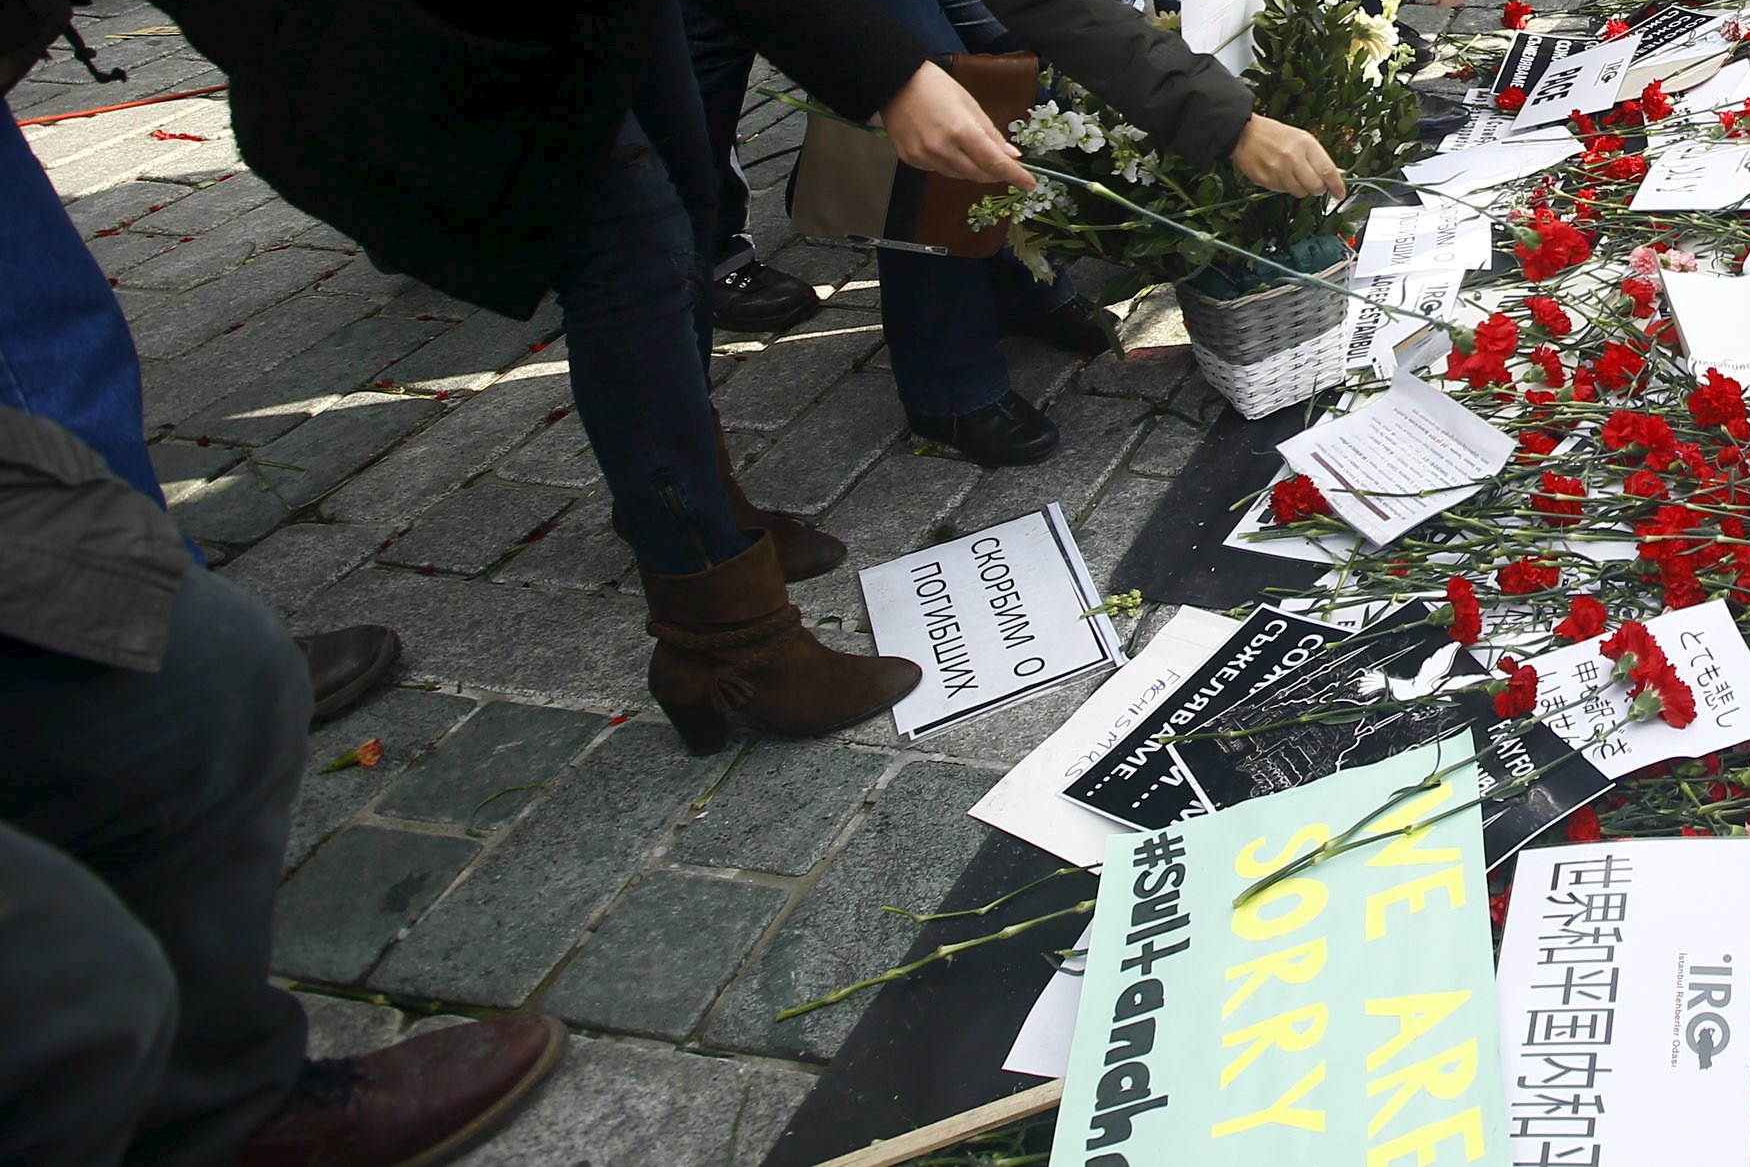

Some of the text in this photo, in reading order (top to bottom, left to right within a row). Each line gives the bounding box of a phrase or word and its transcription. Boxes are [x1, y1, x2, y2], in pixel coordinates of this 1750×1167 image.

[1531, 65, 1584, 107] PACE
[1345, 307, 1383, 363] ESTAMBUL
[910, 560, 981, 701] ПОГИБШИХ
[970, 535, 1031, 658] СКОРБИМ
[1085, 829, 1192, 1167] #Sultanah
[1209, 820, 1331, 1140] SORRY
[1363, 779, 1487, 1167] WE ARE
[1673, 994, 1684, 1039] Rehberler
[1670, 1039, 1681, 1069] Odası
